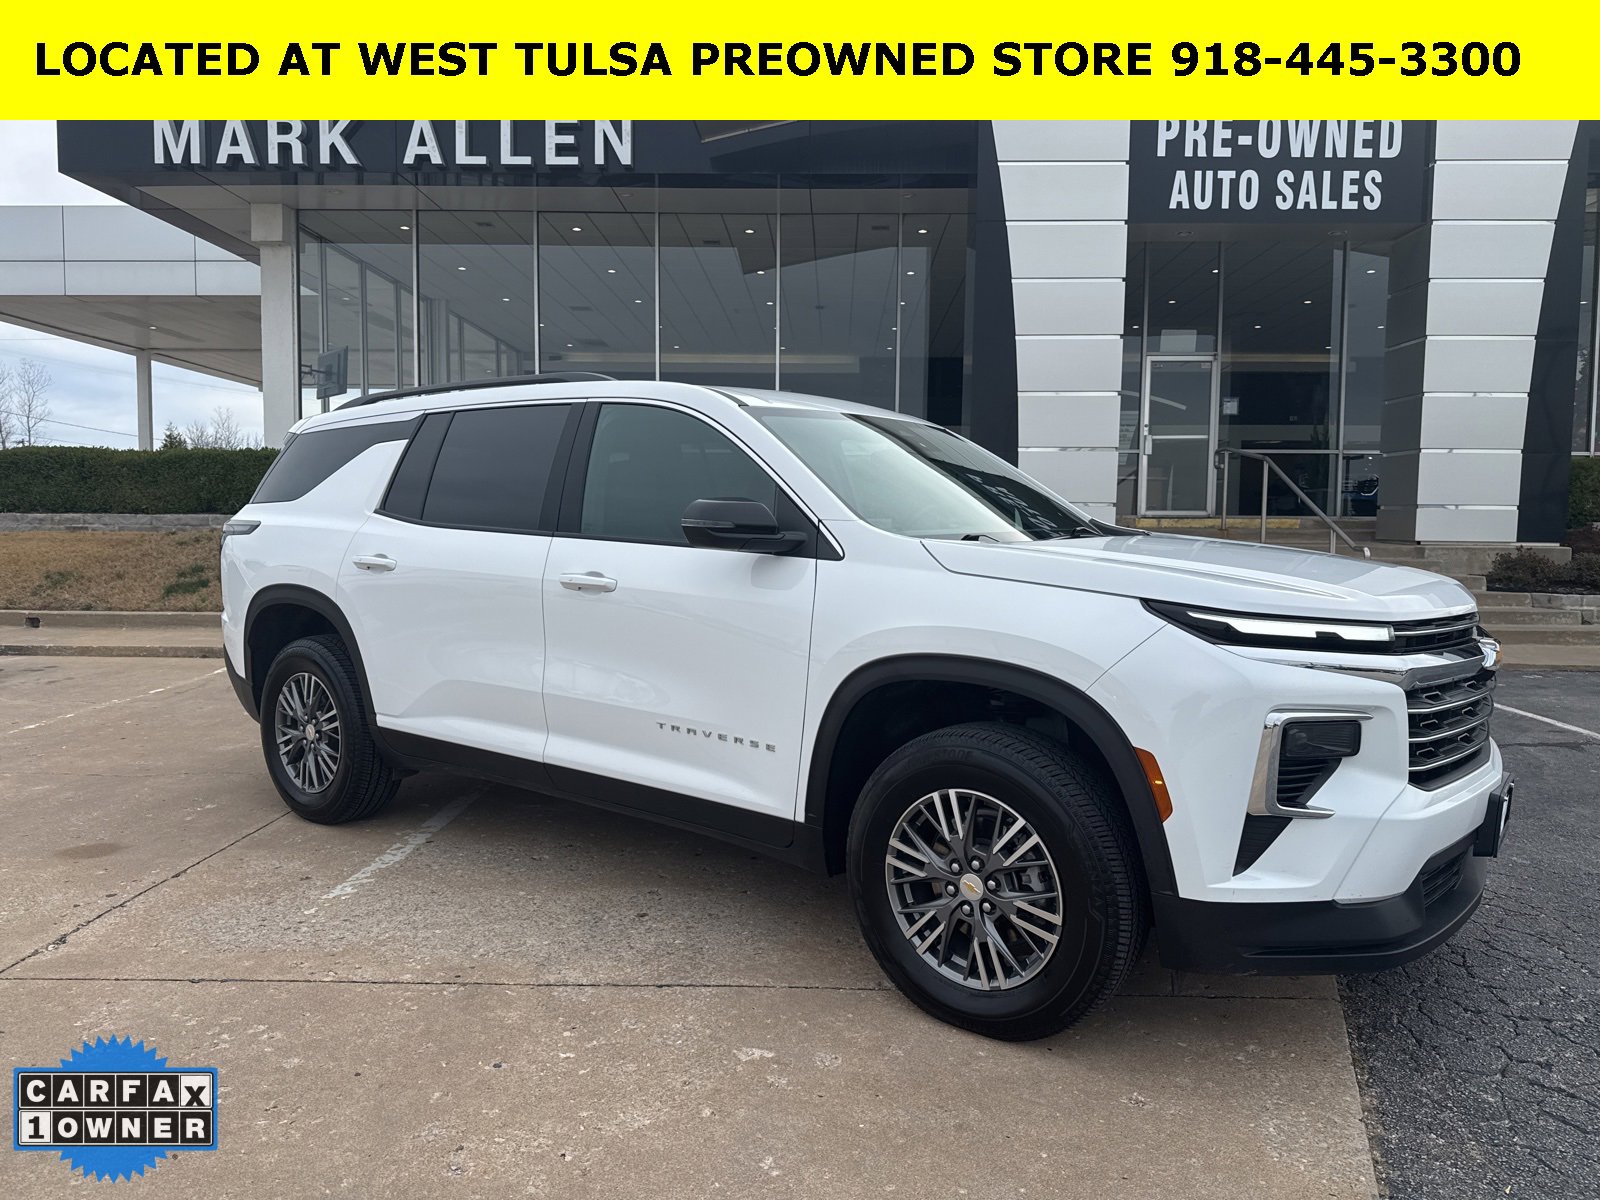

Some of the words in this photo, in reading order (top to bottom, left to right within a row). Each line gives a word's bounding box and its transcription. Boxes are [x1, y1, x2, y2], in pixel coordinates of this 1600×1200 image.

[153, 120, 361, 166] MARK
[402, 120, 634, 167] ALLEN
[1156, 120, 1403, 159] PRE-OWNED
[1168, 169, 1260, 210] AUTO
[1275, 169, 1383, 210] SALES
[656, 721, 776, 752] TRAVERSE
